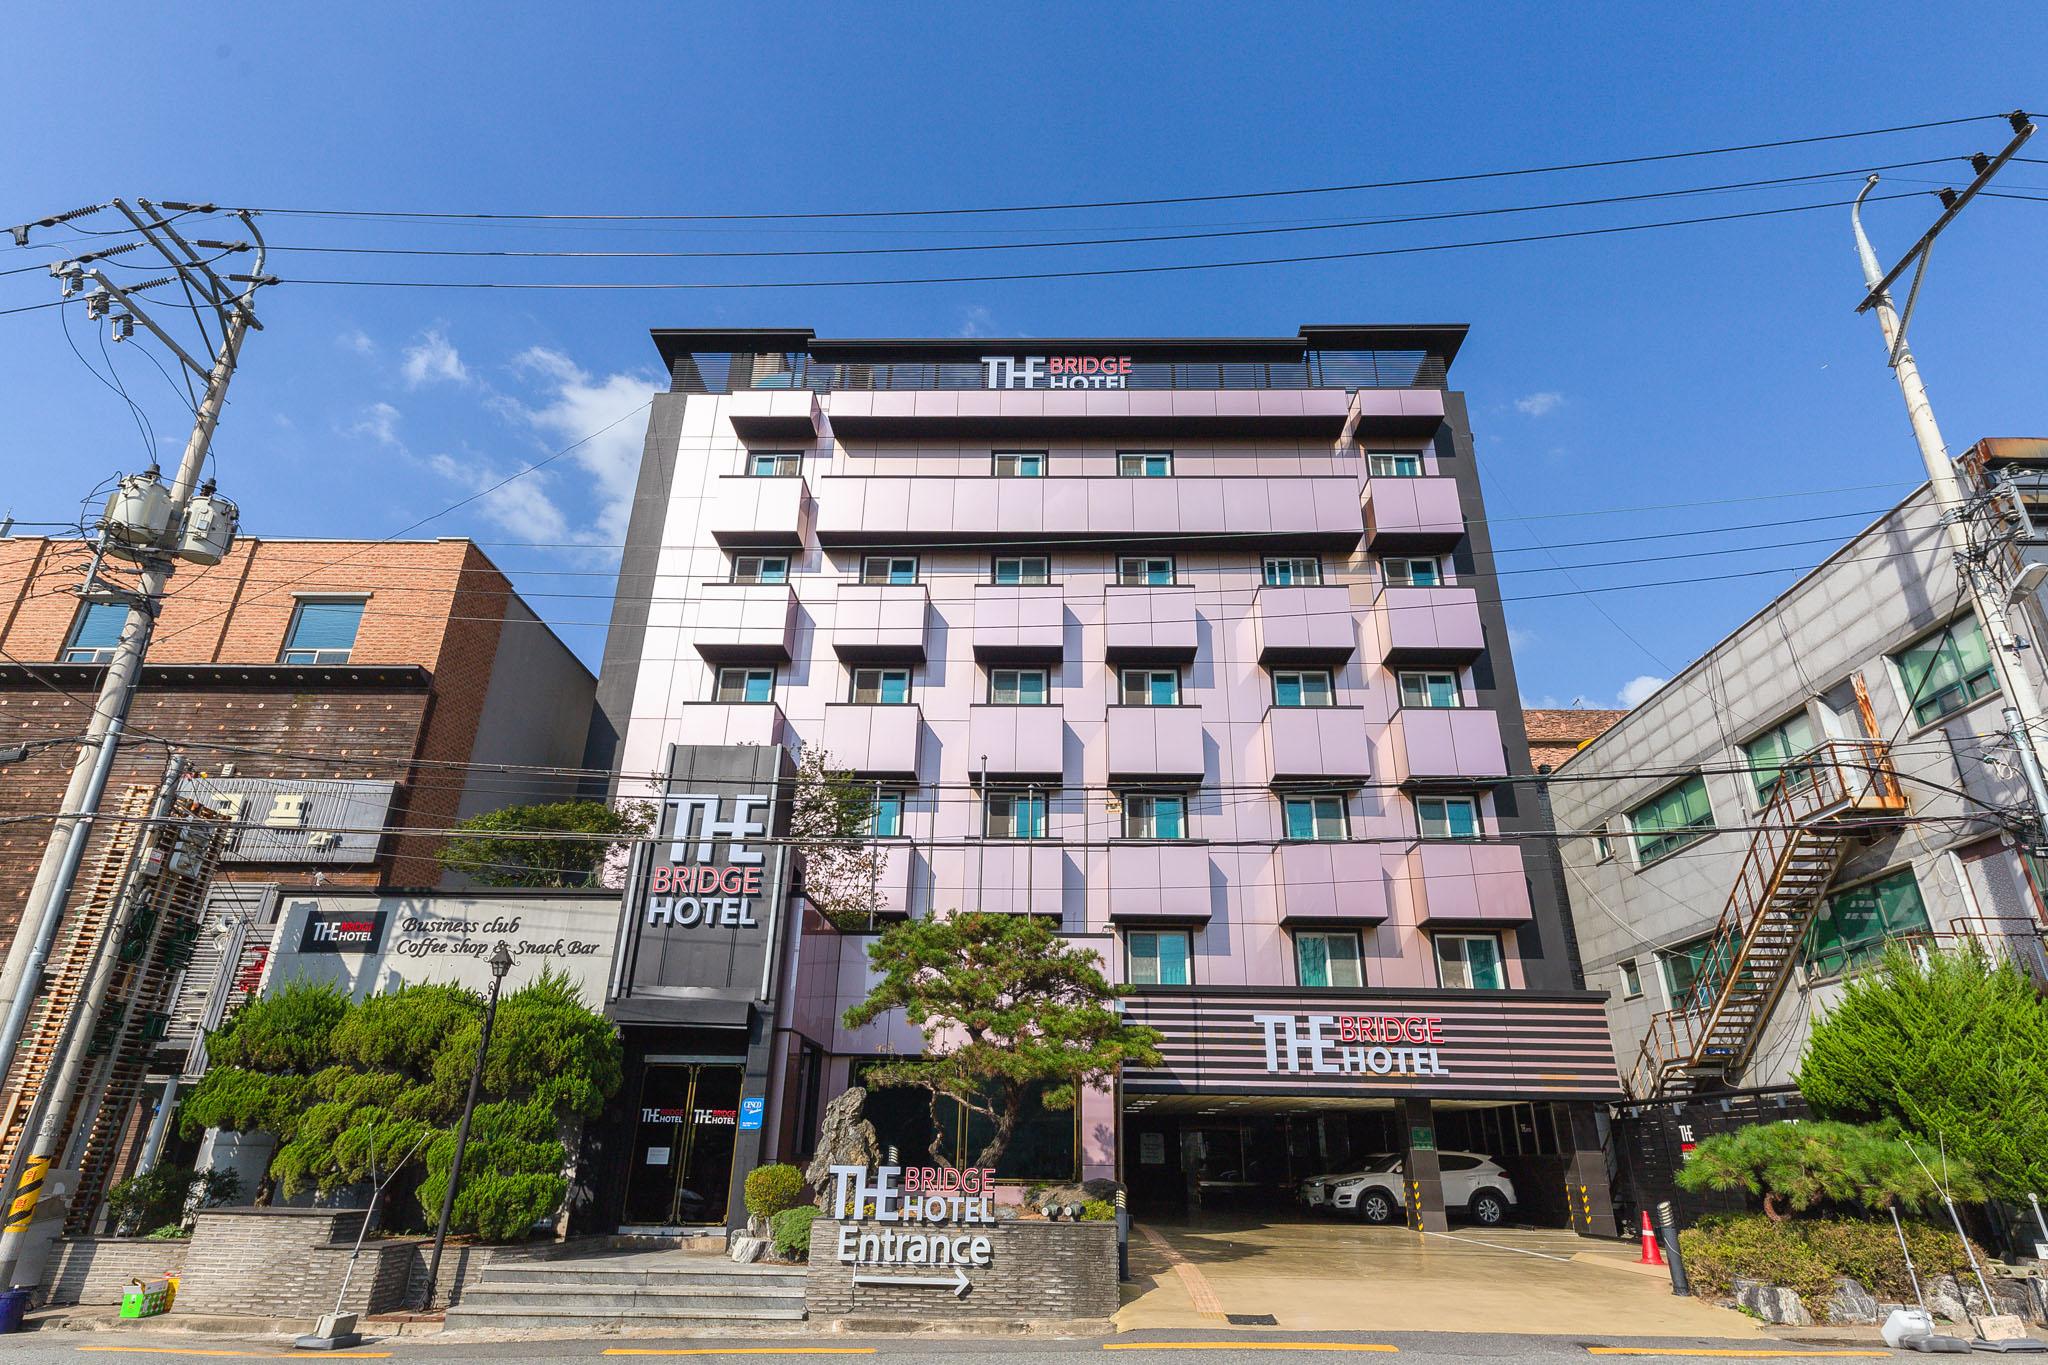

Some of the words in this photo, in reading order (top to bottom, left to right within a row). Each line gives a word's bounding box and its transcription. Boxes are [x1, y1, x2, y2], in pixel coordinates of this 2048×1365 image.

[980, 356, 1046, 389] THE
[1050, 356, 1133, 375] BRIDGE
[666, 794, 768, 863] THE
[653, 867, 762, 894] BRIDGE
[648, 897, 756, 925] HOTEL
[313, 922, 341, 941] THE
[341, 921, 375, 932] BRIDGE
[402, 917, 479, 933] Business
[482, 916, 522, 933] club
[338, 932, 373, 942] HOTEL
[396, 938, 449, 958] Coffee
[450, 938, 489, 959] shop
[513, 938, 567, 958] Snack
[567, 940, 600, 955] Bar
[1253, 1015, 1340, 1073] THE
[1339, 1016, 1446, 1044] BRIDGE
[1342, 1046, 1449, 1075] HOTEL
[642, 1108, 660, 1123] THE
[660, 1115, 683, 1124] HOTEL
[694, 1109, 712, 1124] THE
[711, 1117, 736, 1126] HOTEL
[1679, 1125, 1695, 1142] THE
[829, 1165, 901, 1221] THE
[904, 1167, 997, 1193] BRIDGE
[903, 1195, 996, 1223] HOTEL
[837, 1225, 991, 1264] Entrance
